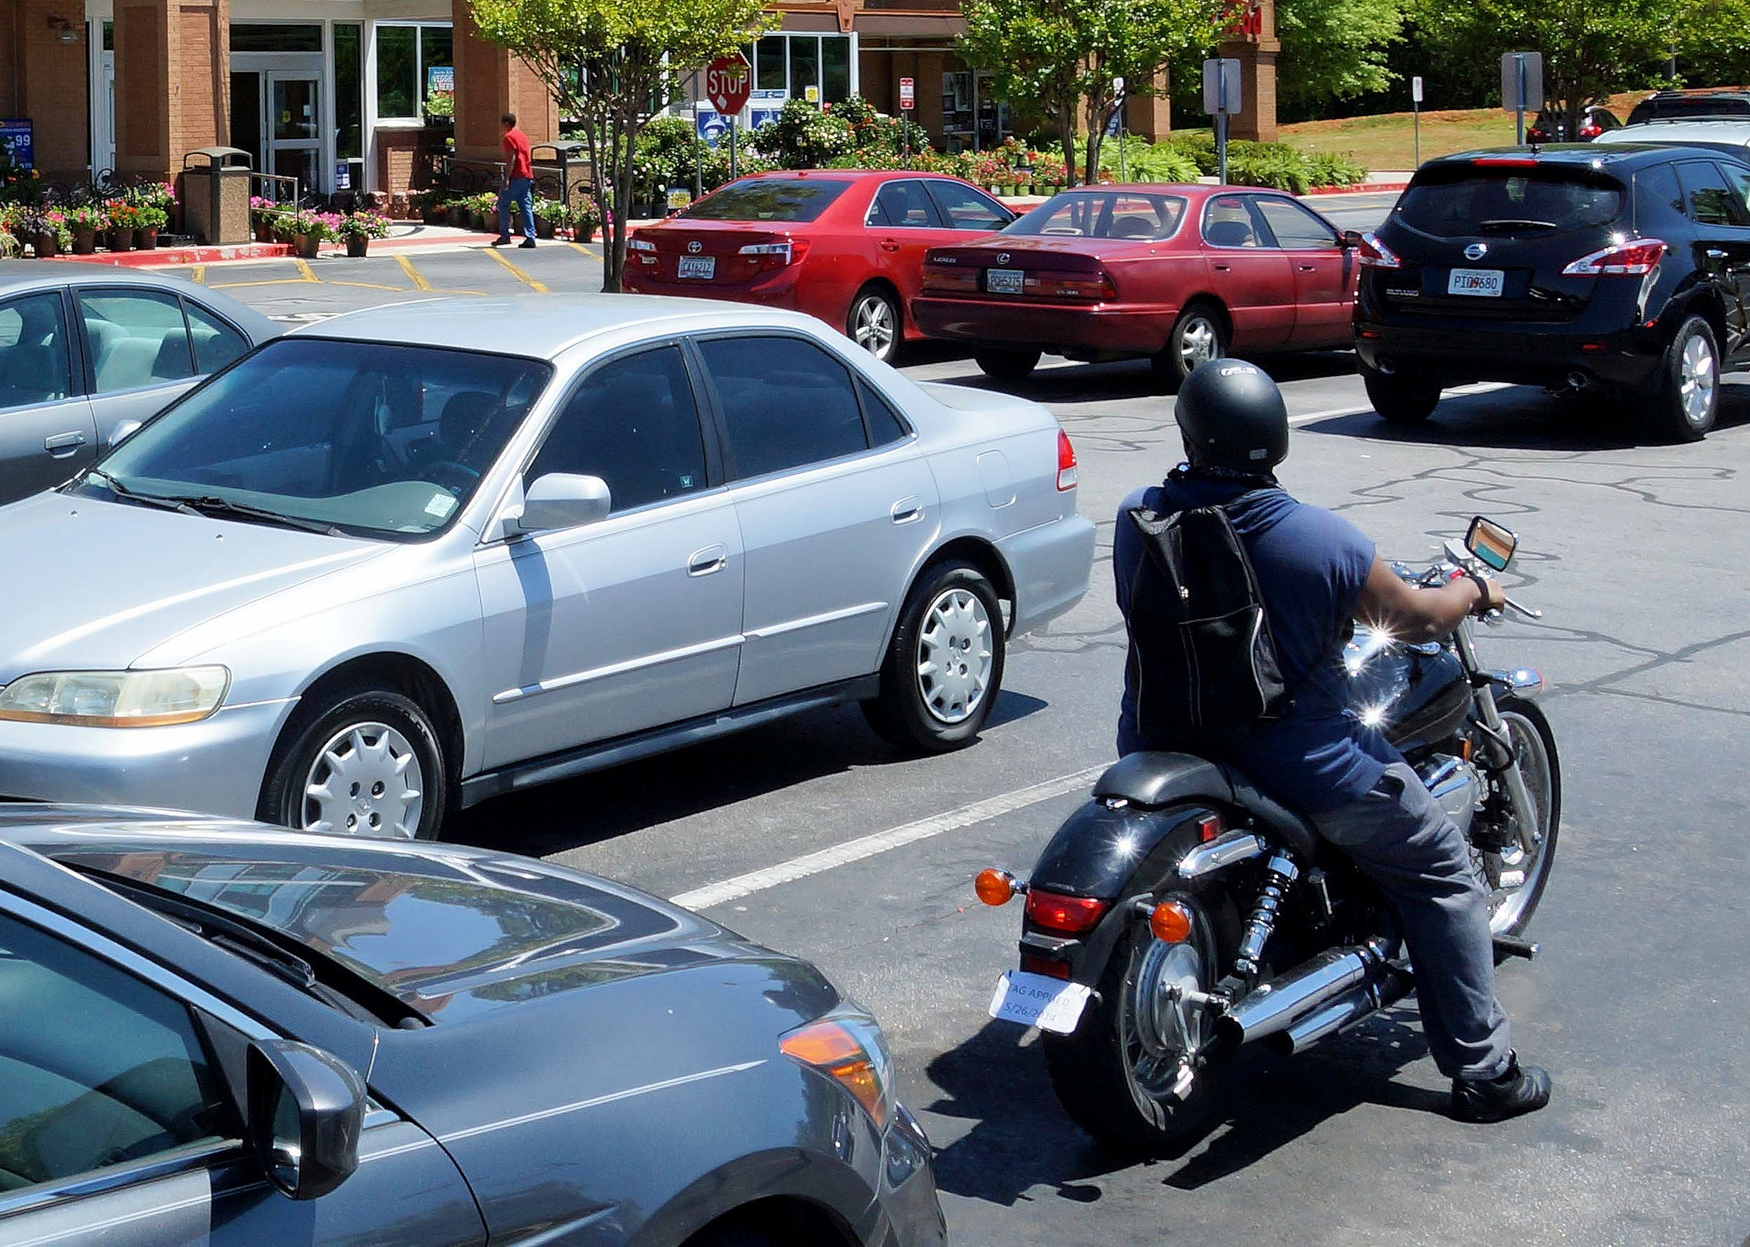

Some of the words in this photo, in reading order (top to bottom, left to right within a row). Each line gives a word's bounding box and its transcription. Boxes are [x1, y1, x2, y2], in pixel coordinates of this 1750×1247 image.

[709, 70, 748, 94] STOP
[15, 135, 30, 146] 99
[1009, 982, 1028, 995] TAG
